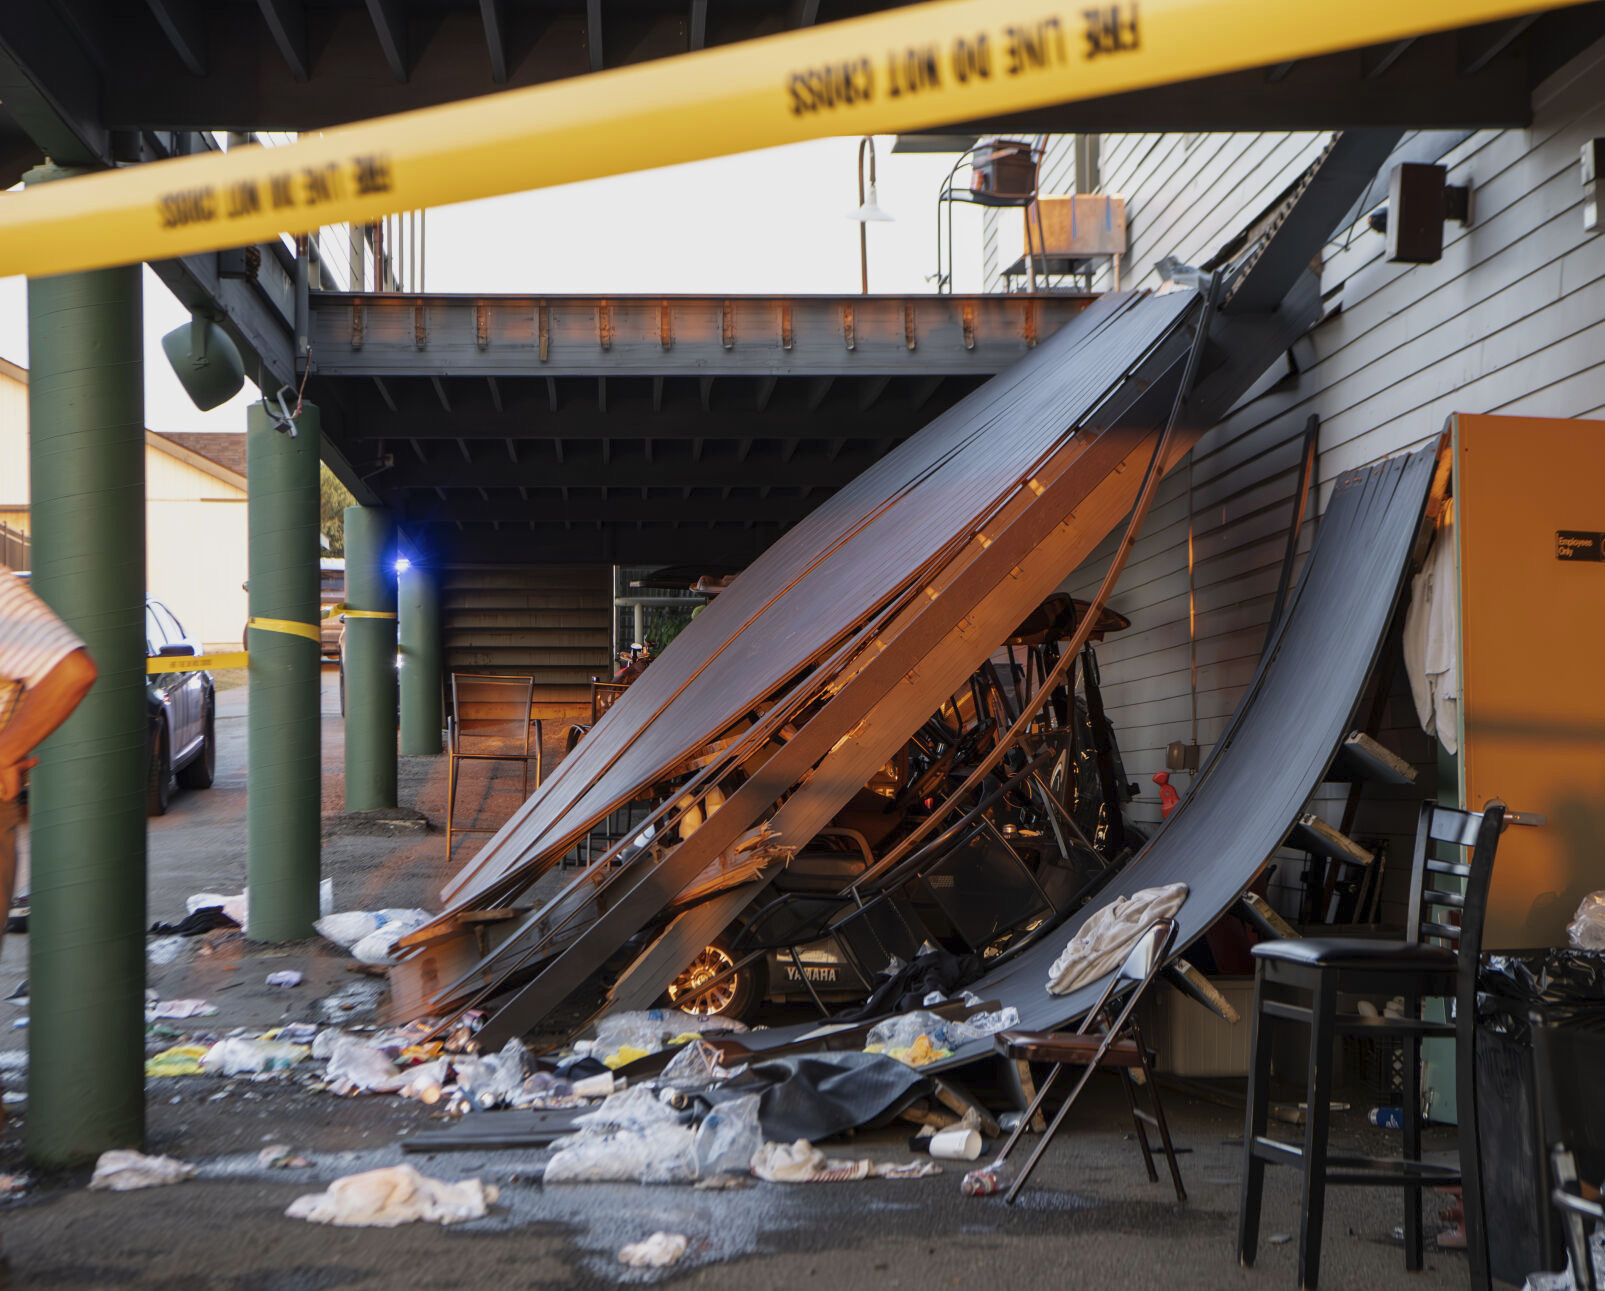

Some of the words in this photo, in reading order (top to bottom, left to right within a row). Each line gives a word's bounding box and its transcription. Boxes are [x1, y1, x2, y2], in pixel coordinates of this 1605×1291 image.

[951, 32, 992, 84] DO
[1004, 17, 1066, 76] LINE
[1081, 4, 1142, 61] FIRE
[786, 56, 872, 116] CROSS
[886, 47, 941, 98] NOT
